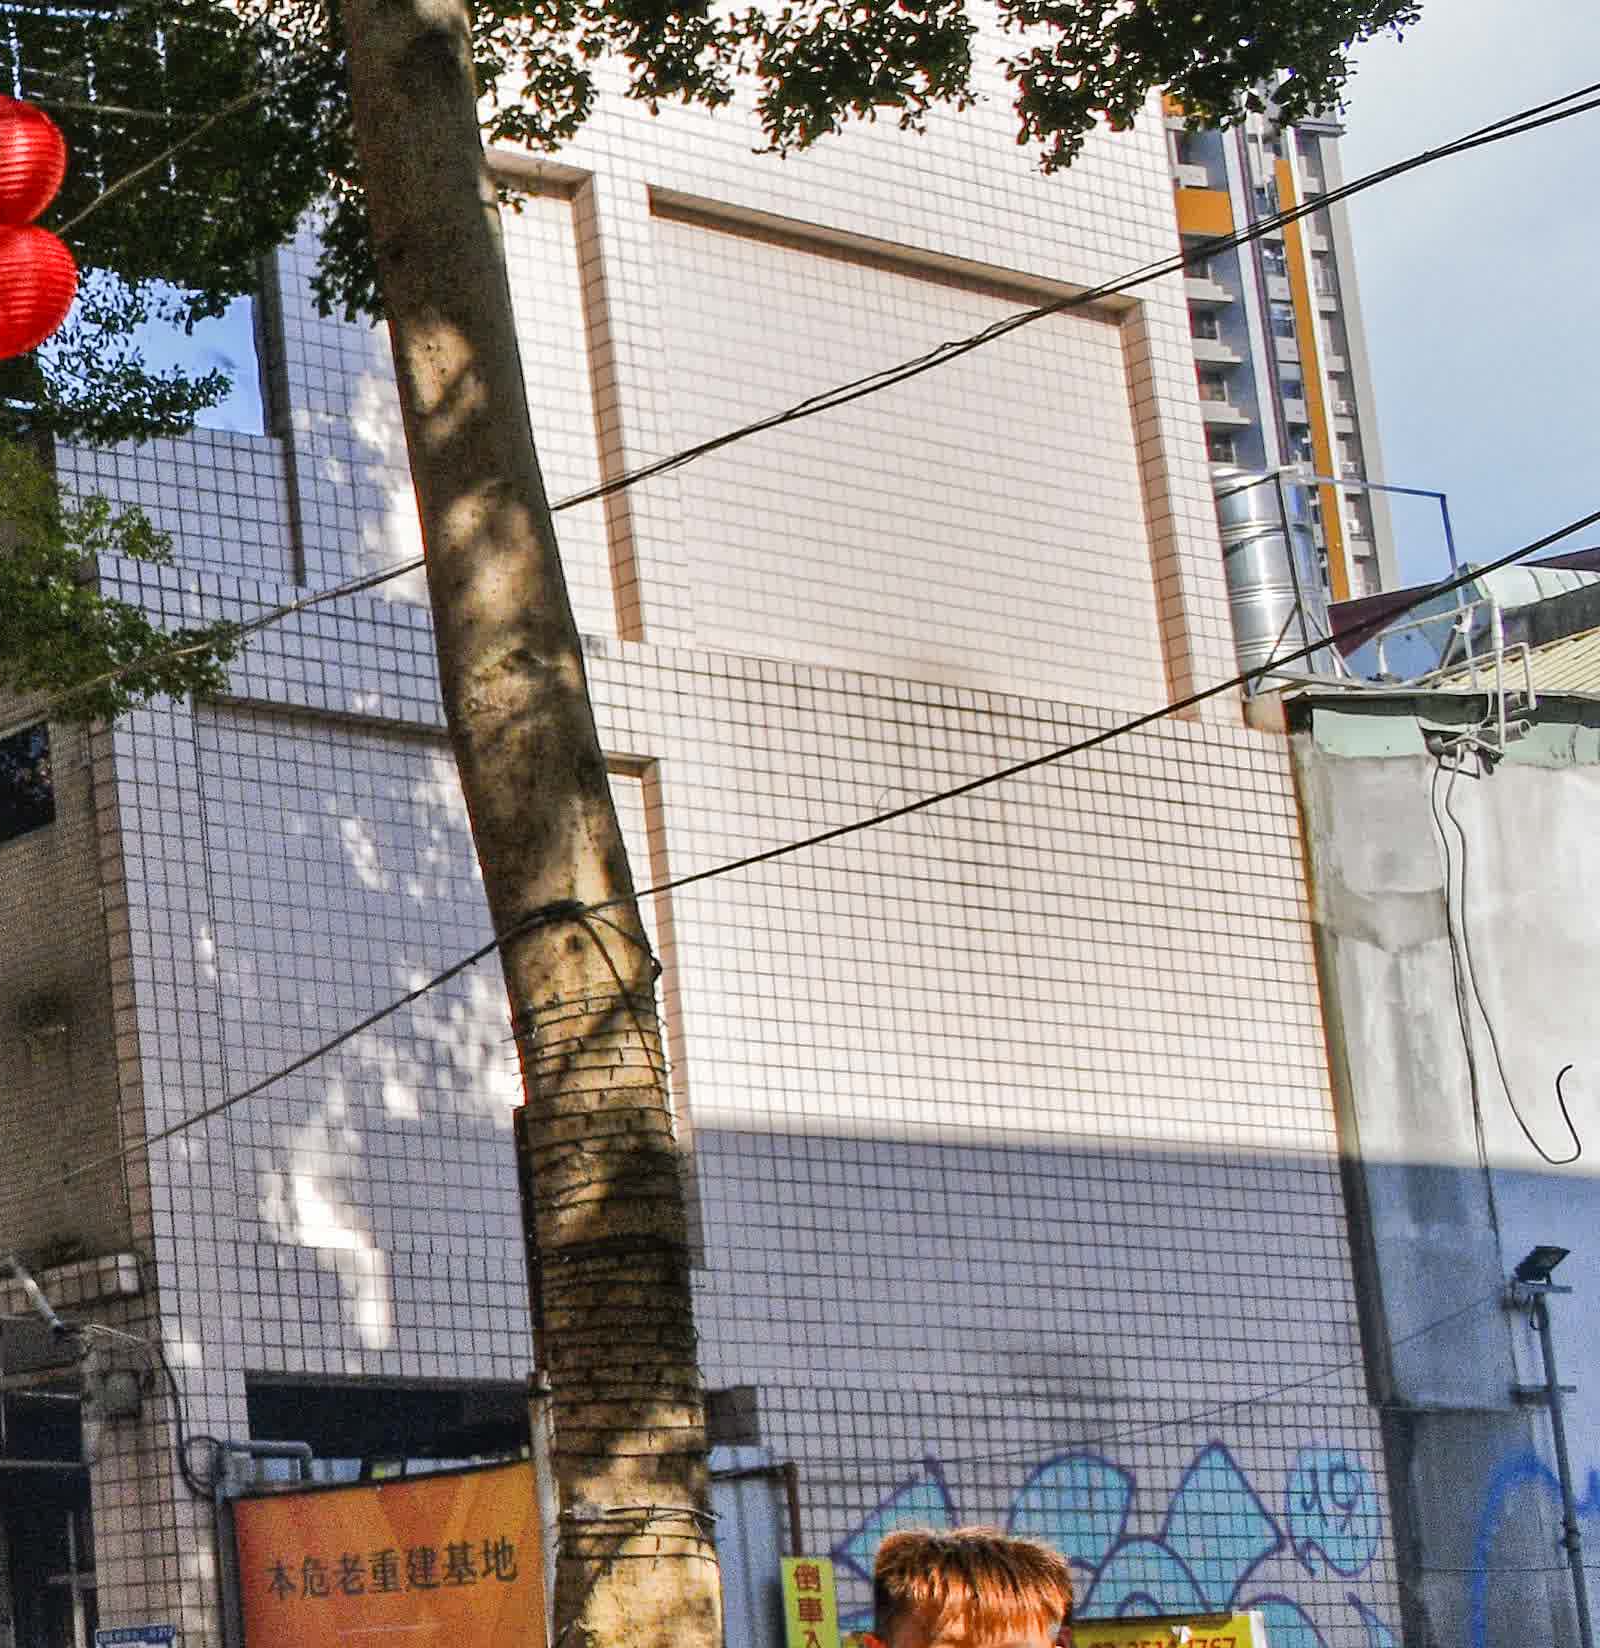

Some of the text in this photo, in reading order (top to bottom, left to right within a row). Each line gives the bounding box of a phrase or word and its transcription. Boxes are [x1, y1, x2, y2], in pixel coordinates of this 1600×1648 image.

[266, 1535, 518, 1602] 本危老重建基地
